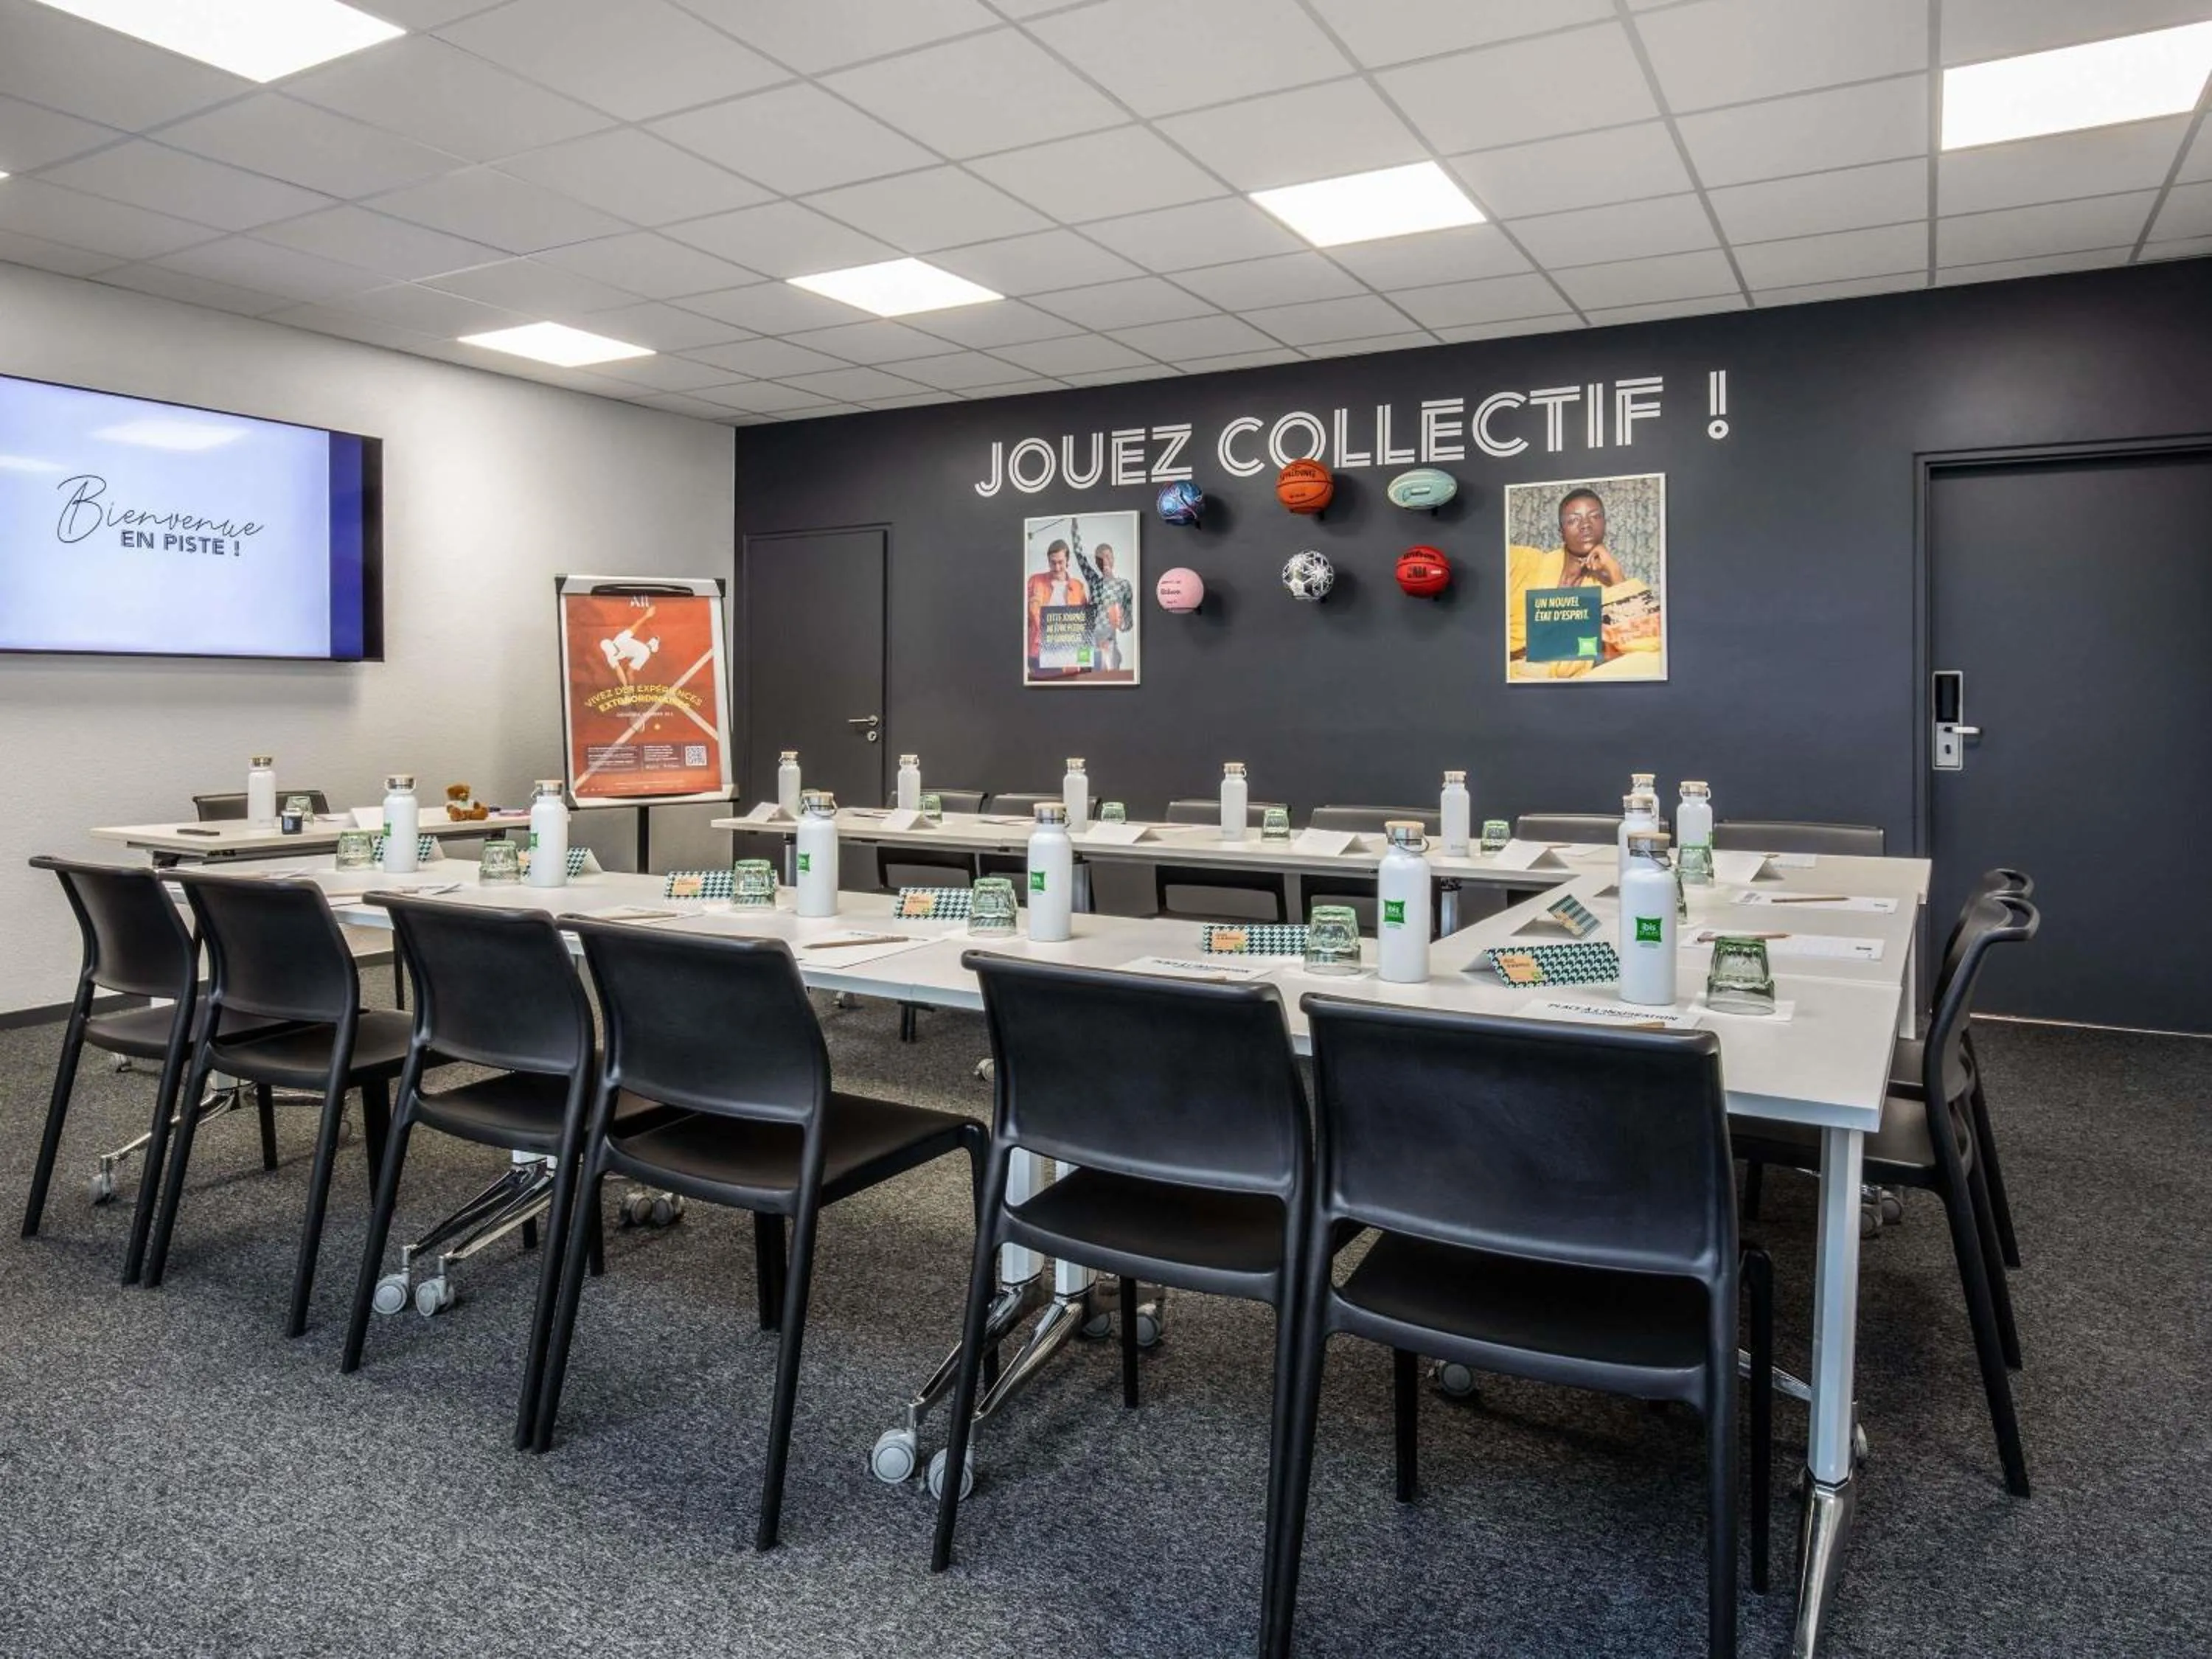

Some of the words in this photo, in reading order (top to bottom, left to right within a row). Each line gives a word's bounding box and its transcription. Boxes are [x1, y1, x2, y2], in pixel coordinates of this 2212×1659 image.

[974, 423, 1193, 498] JOUEZ
[1217, 377, 1664, 477] COLLECTIF
[1707, 369, 1729, 440] !
[56, 473, 265, 544] Bienvenue
[119, 530, 154, 550] EN
[163, 533, 225, 556] PISTE
[233, 540, 240, 557] !
[1534, 598, 1547, 608] UN
[1548, 596, 1579, 608] NOUVEL
[1534, 608, 1552, 622] ÉTAT
[584, 689, 613, 707] VIVEZ
[1641, 922, 1656, 931] ibis
